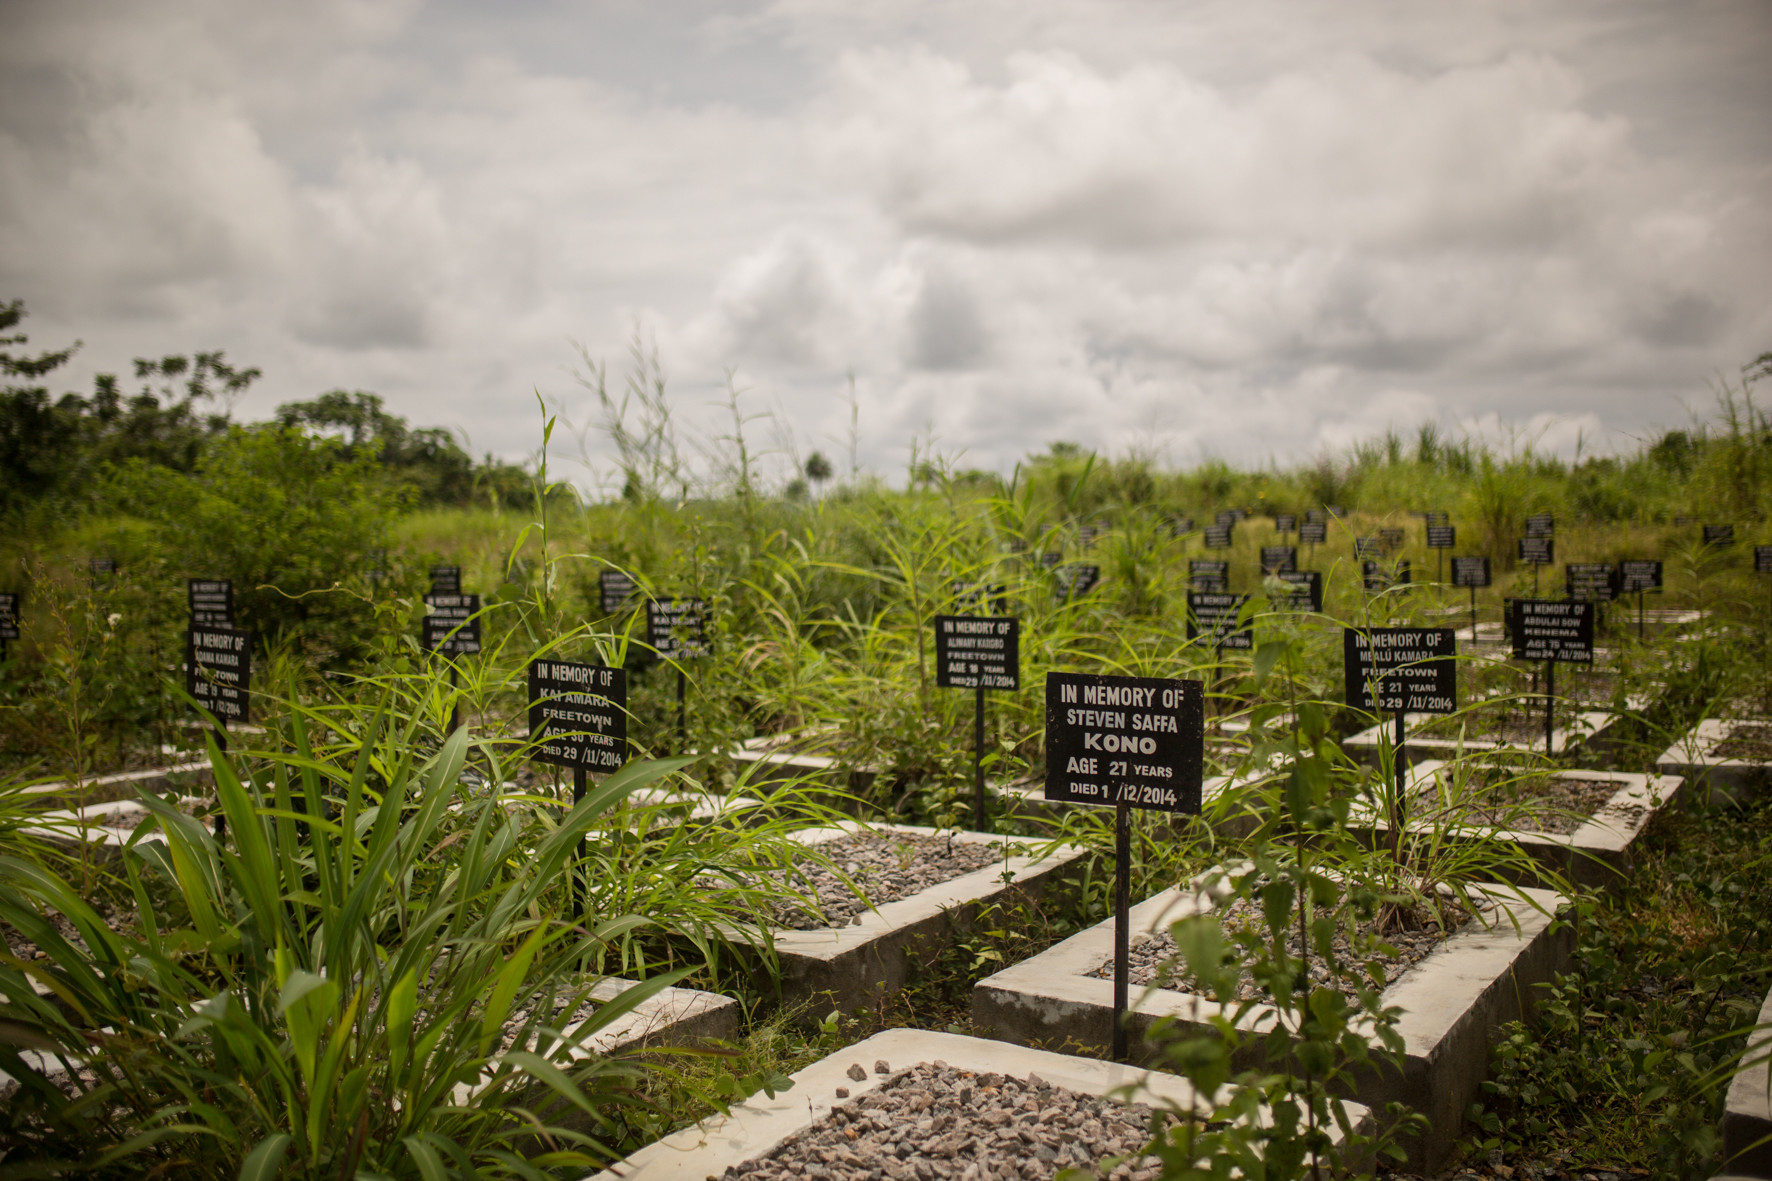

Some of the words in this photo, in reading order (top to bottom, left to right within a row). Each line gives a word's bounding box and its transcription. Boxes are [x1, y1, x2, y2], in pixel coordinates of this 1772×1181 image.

[1522, 604, 1532, 614] IN
[1534, 604, 1571, 615] MEMORY
[1574, 605, 1585, 615] OF
[943, 621, 953, 633] IN
[956, 621, 995, 634] MEMORY
[998, 622, 1010, 635] OF
[1524, 616, 1560, 626] ABDULAI
[1524, 628, 1578, 637] KENEMA
[193, 632, 201, 646] IN
[203, 633, 233, 649] MEMORY
[235, 637, 244, 651] OF
[1356, 635, 1367, 648] IN
[1372, 633, 1421, 648] MEMORY
[1426, 633, 1442, 647] OF
[1527, 640, 1546, 648] AGE
[215, 653, 239, 667] KAMARA
[947, 652, 1005, 661] FREETOWN
[1394, 651, 1434, 662] KAMARA
[948, 662, 966, 673] AGE
[1362, 668, 1437, 677] FREETOWN
[537, 663, 548, 679] IN
[552, 665, 595, 684] MEMORY
[600, 671, 613, 687] OF
[195, 682, 208, 696] AGE
[1389, 682, 1402, 692] 27
[1409, 684, 1437, 692] YEARS
[1061, 684, 1077, 704] IN
[1084, 685, 1156, 707] MEMORY
[1162, 689, 1184, 709] OF
[1365, 698, 1385, 707] DID
[1386, 698, 1402, 708] 29
[543, 708, 612, 726] FREETOWN
[1067, 709, 1126, 728] STEVEN
[1132, 714, 1178, 733] SAFFA
[543, 726, 566, 740] AGE
[589, 735, 614, 746] YEARS
[1084, 732, 1157, 755] KONO
[543, 744, 561, 755] DIED
[563, 746, 577, 760] 29
[1066, 756, 1098, 775] AGE
[1109, 761, 1127, 776] 27
[1134, 765, 1173, 778] YEARS
[1070, 782, 1098, 795] DIED
[1101, 785, 1109, 798] 1
